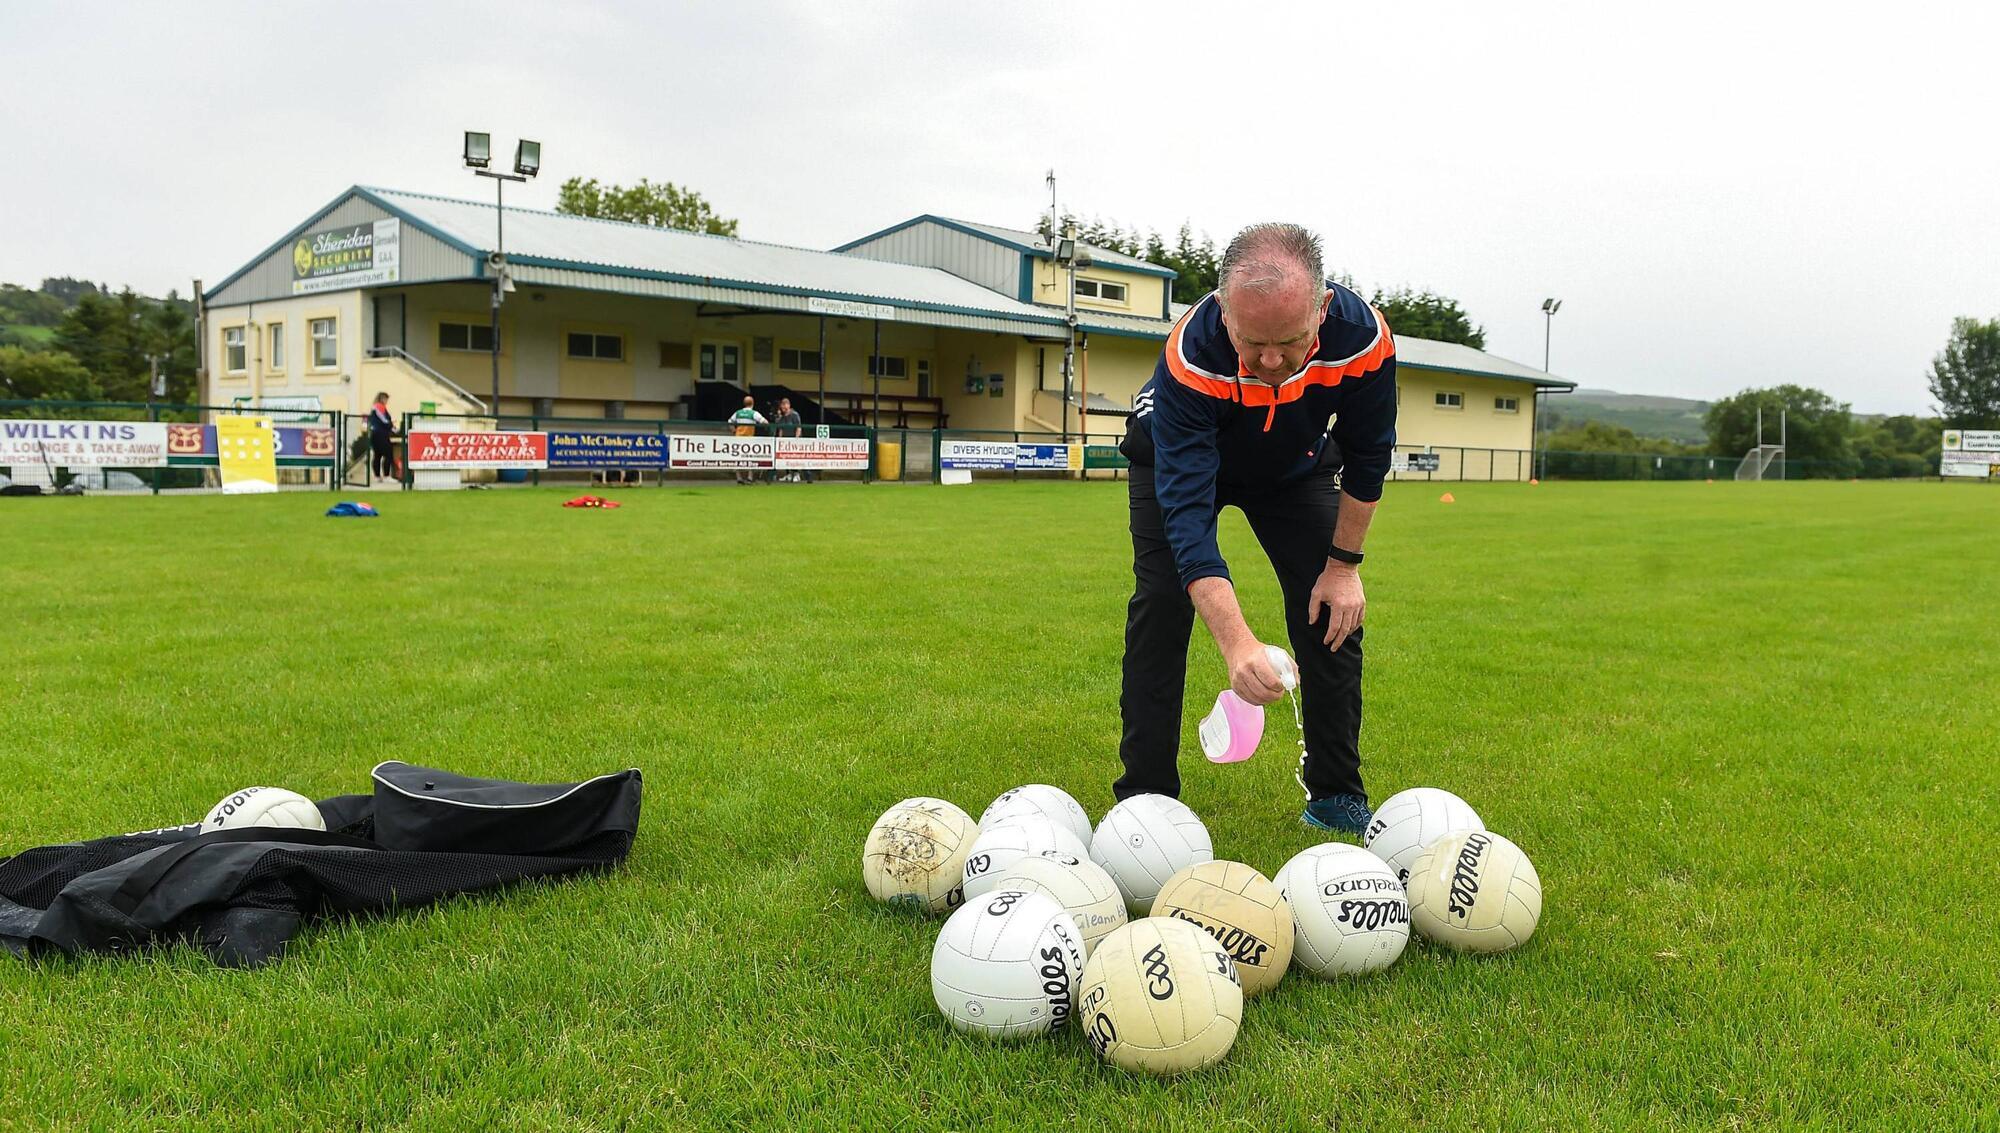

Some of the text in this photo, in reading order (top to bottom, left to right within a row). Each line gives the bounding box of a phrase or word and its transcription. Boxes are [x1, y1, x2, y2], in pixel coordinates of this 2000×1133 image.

[313, 227, 372, 255] Sheridan
[313, 248, 372, 268] SECURITY
[5, 423, 136, 440] WILKINS
[818, 426, 829, 438] 65
[447, 434, 511, 446] COUNTY
[552, 434, 663, 449] John McCloskey & Co.
[13, 442, 70, 454] LOUNGE
[75, 443, 85, 454] &
[91, 443, 161, 454] TAKE-AWAY
[421, 446, 537, 457] DRY CLEANERS
[673, 437, 772, 457] The Lagoon
[778, 441, 867, 452] Edward Brown Ltd
[953, 445, 1015, 456] DIVERS HYUNDAI
